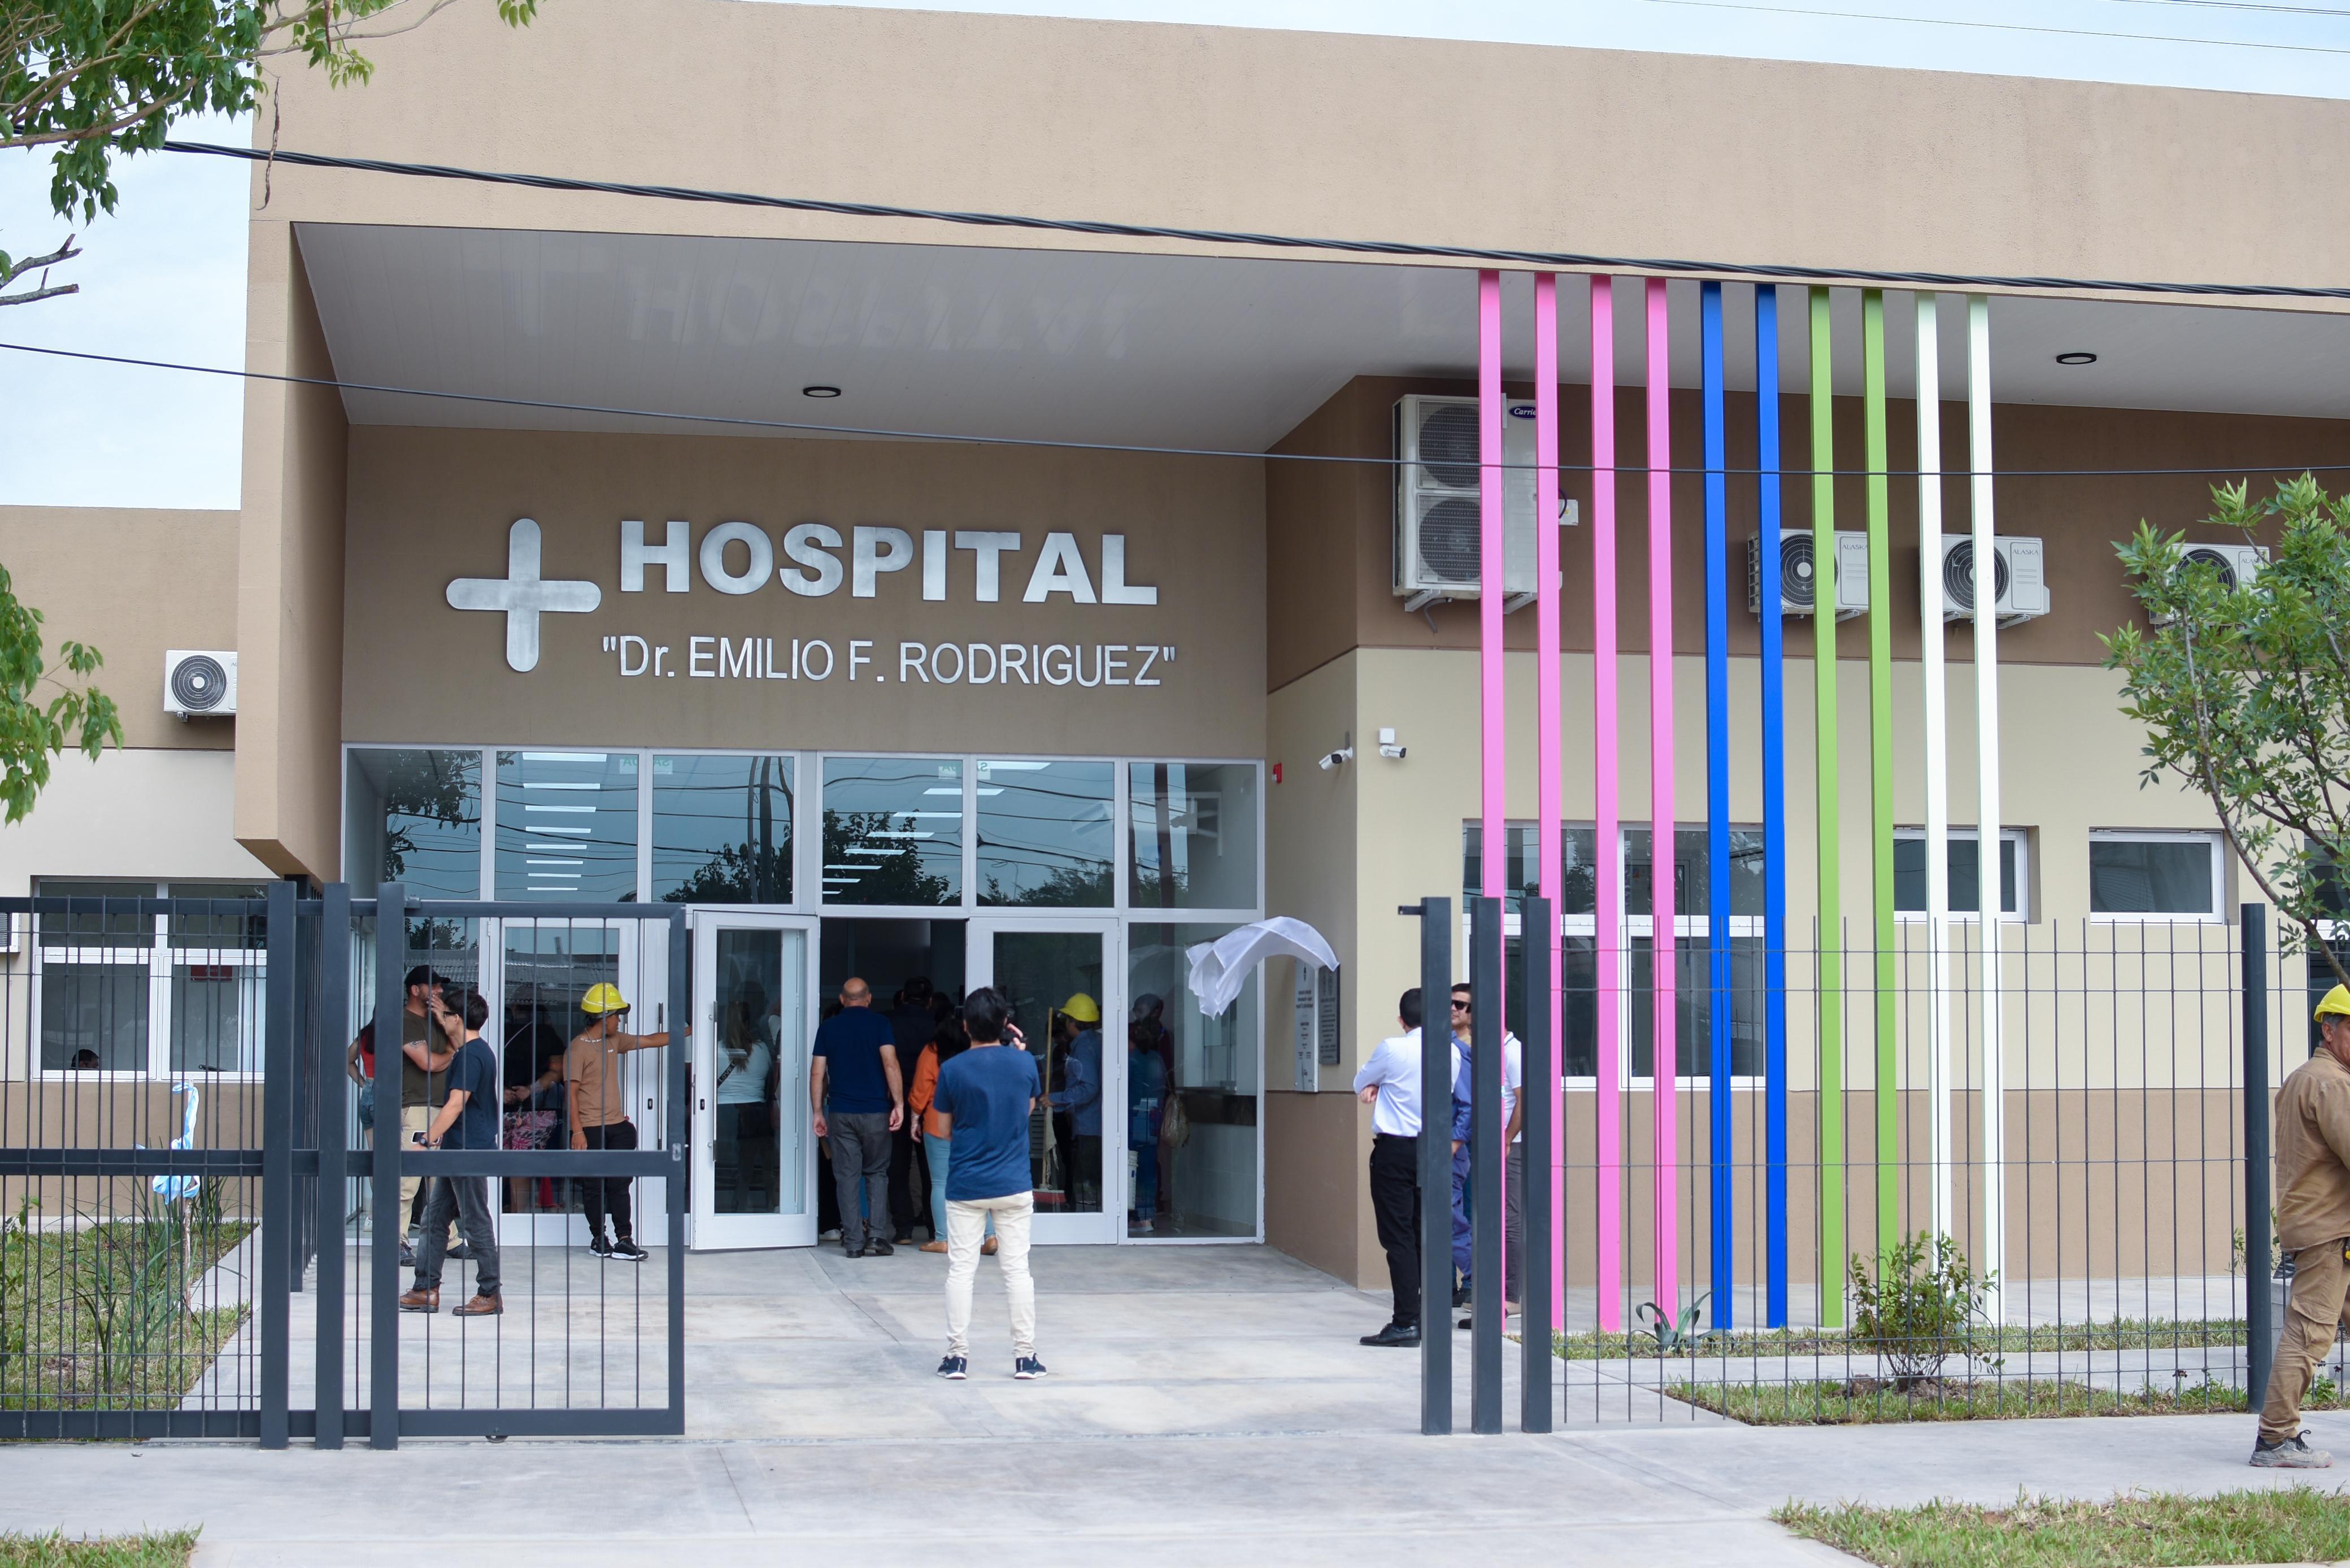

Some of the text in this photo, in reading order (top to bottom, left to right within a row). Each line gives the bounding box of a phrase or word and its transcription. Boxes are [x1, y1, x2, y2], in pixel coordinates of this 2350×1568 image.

[621, 521, 1157, 605] HOSPITAL
[603, 635, 1175, 687] "Dr. EMILIO F. RODRIGUEZ"
